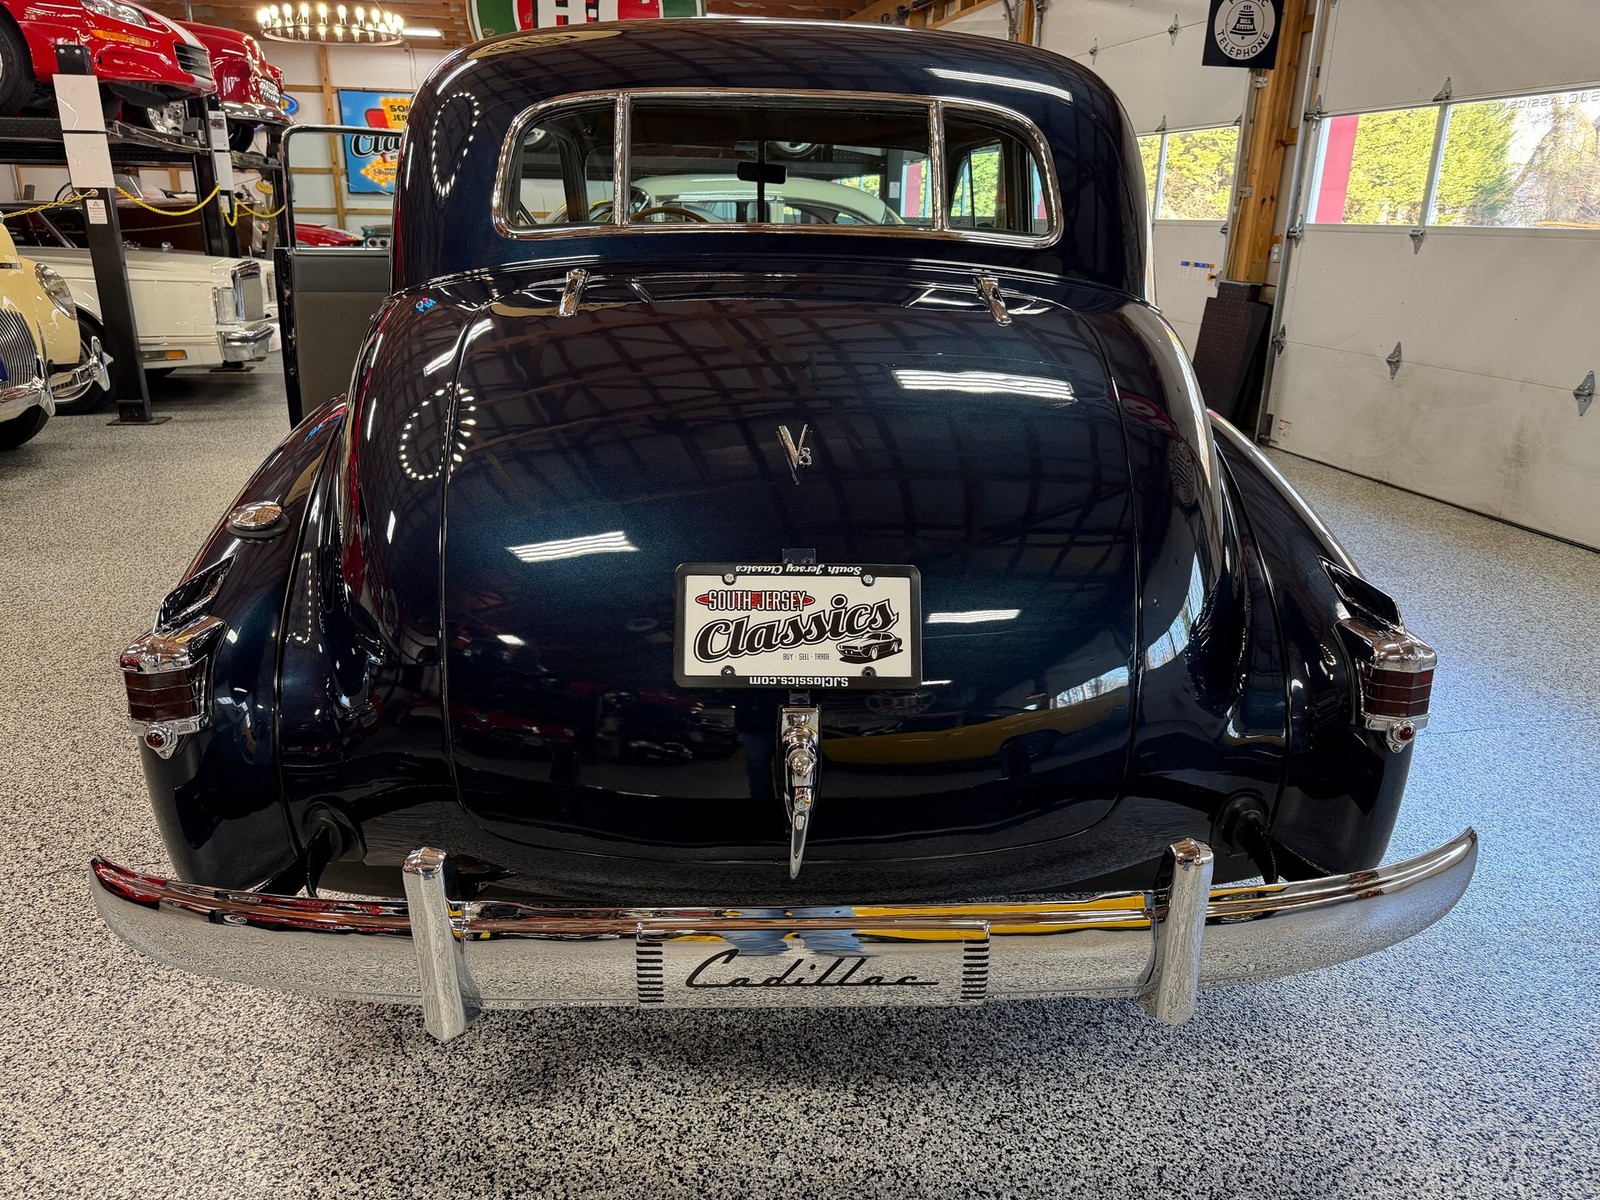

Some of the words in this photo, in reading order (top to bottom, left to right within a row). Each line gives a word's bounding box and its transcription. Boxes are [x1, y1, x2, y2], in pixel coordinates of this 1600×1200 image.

[1217, 29, 1270, 58] TELEPHONE
[735, 564, 783, 575] Classics
[786, 564, 825, 575] Jersey
[828, 565, 862, 575] South
[708, 590, 751, 611] SOUTH
[756, 590, 806, 611] JERSEY
[694, 594, 899, 663] Classics
[782, 653, 793, 661] BUY
[798, 653, 810, 661] SELL
[814, 653, 830, 661] TRADE
[749, 676, 849, 687] SJClassics.com
[685, 948, 939, 988] Cadillac
